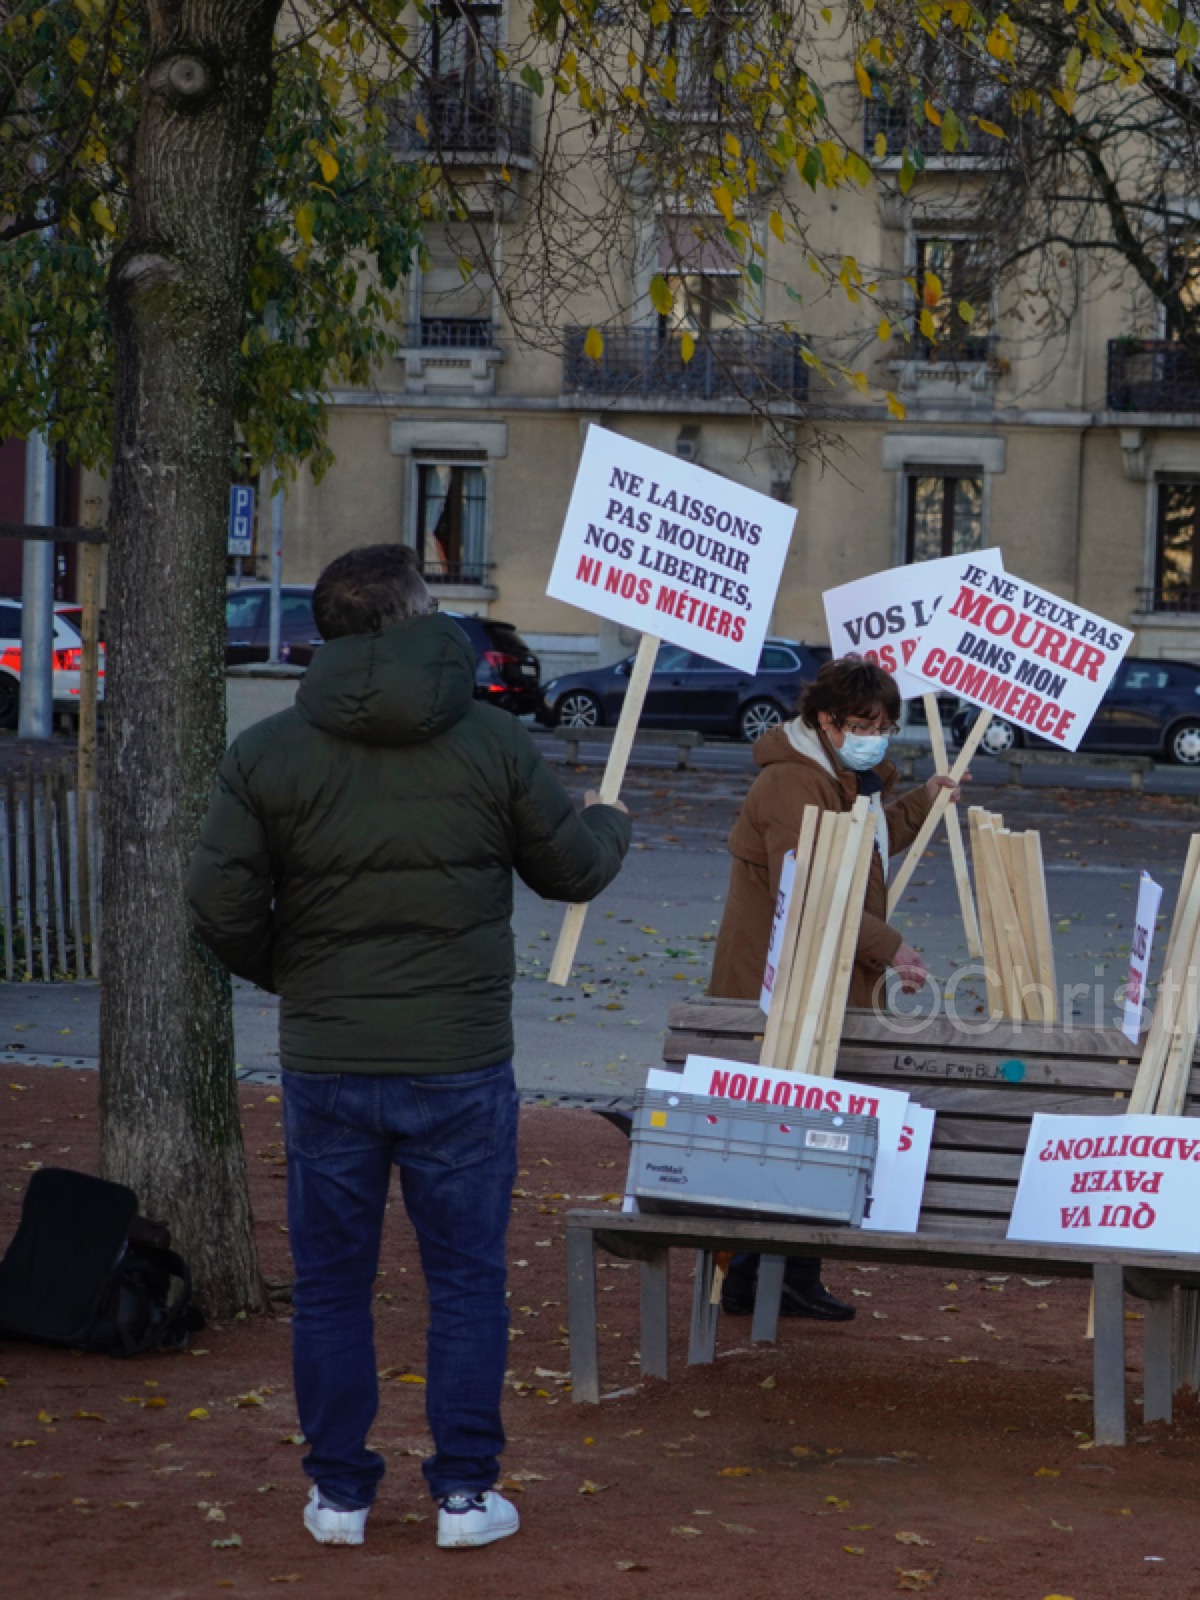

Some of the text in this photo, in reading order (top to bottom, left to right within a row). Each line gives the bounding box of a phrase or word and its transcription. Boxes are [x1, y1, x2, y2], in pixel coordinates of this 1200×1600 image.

[236, 489, 249, 514] P
[605, 498, 750, 575] PAS MOURIR
[609, 466, 763, 546] NE LAISSONS
[576, 555, 747, 643] NI NOS MÉTIERS
[583, 523, 752, 611] NOS LIBERTES,
[842, 605, 906, 647] VOS
[948, 585, 1106, 683] MOURIR
[959, 564, 1123, 651] JE NE VEUX PAS
[921, 647, 1076, 741] COMMERCE
[956, 631, 1067, 700] DANS MON
[1060, 1202, 1156, 1230] QUI VA
[1070, 1170, 1164, 1194] PAYER
